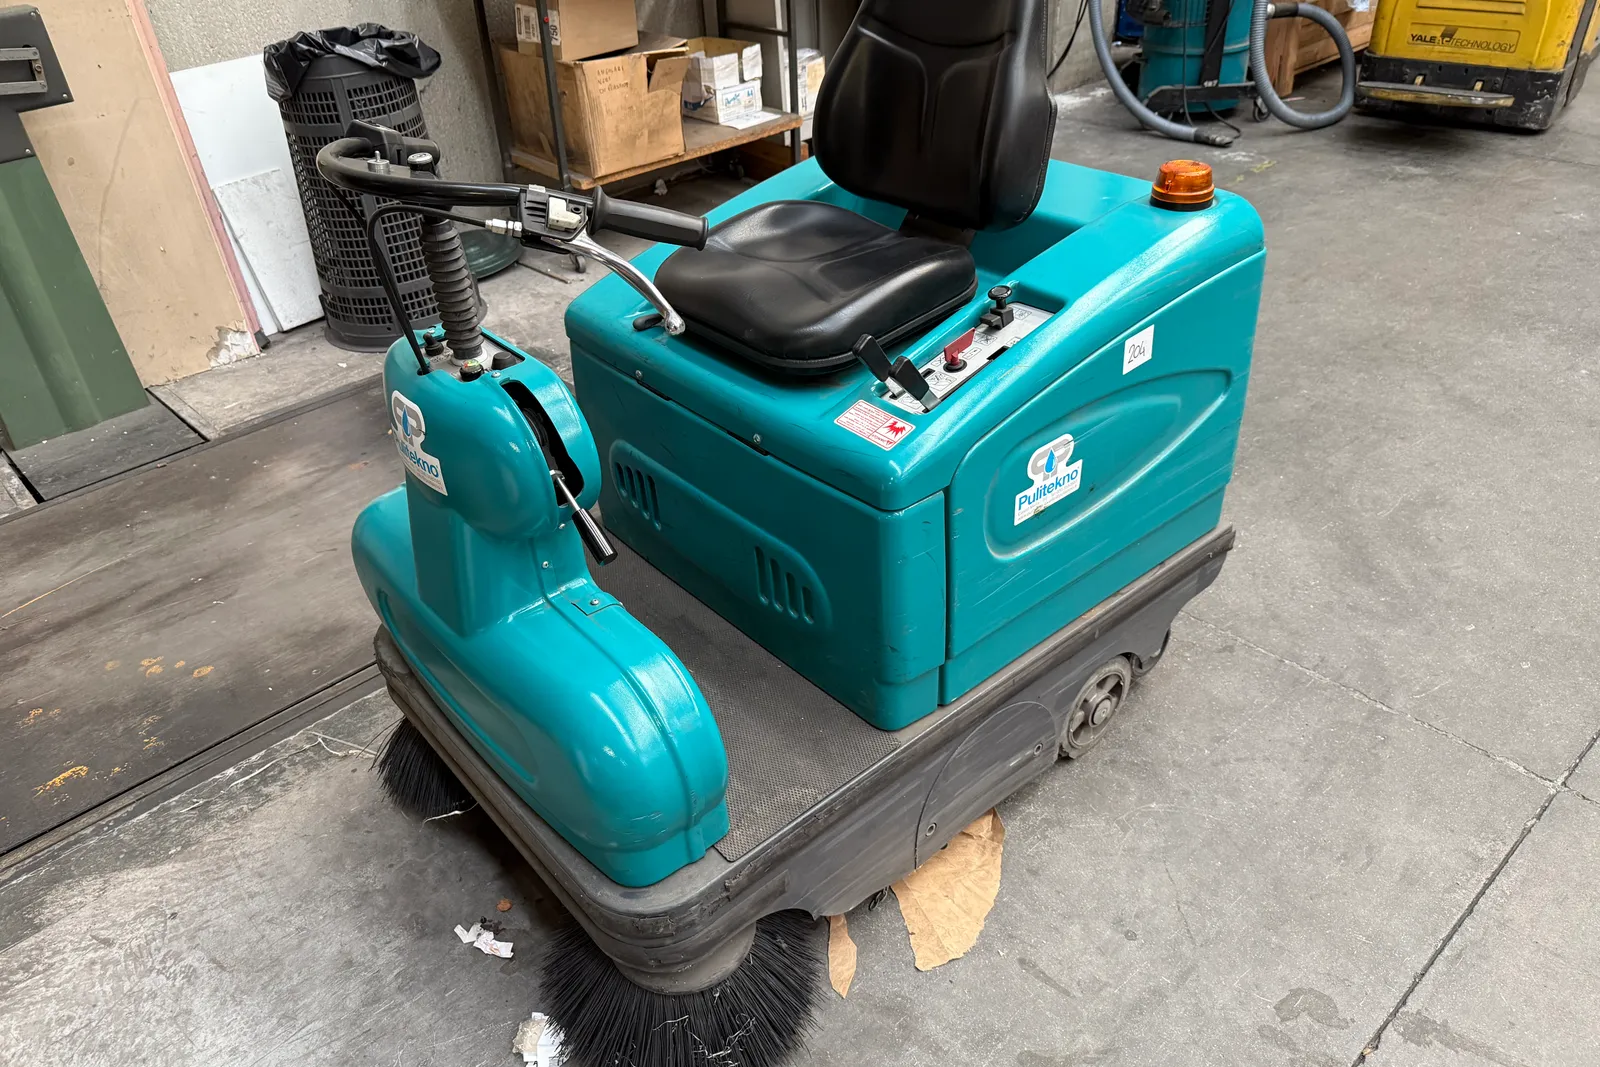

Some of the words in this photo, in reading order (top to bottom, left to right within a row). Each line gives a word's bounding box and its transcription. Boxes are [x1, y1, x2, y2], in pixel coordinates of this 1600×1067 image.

[1410, 33, 1437, 44] YALE
[1450, 37, 1515, 51] TECHNOLOGY
[1128, 340, 1146, 364] 204
[1018, 469, 1079, 511] Pulitekno
